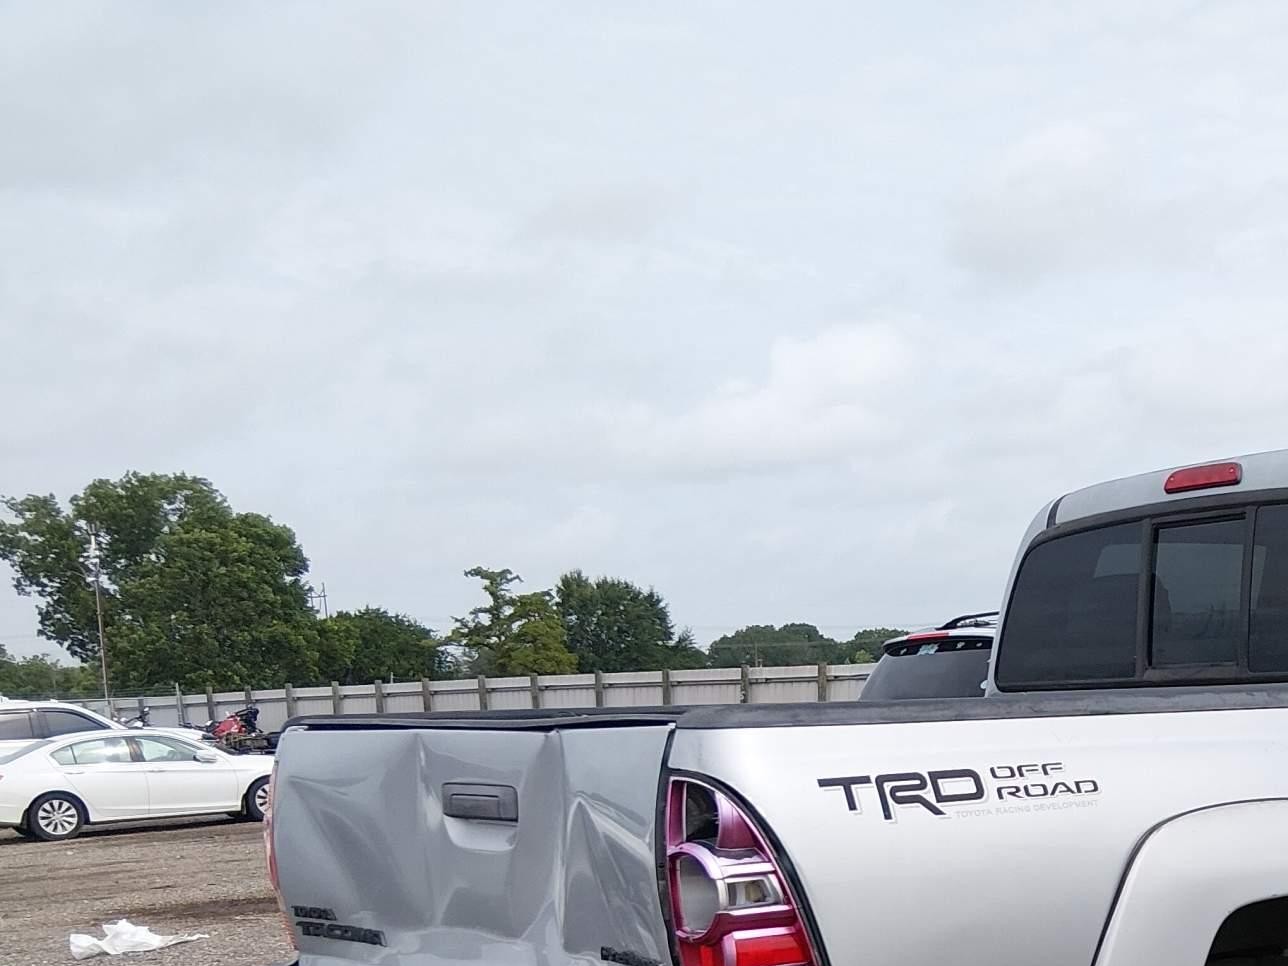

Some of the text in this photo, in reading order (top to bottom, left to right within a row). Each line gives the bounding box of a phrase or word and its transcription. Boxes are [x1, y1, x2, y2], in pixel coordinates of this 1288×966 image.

[990, 762, 1063, 779] OFF
[817, 767, 985, 821] TRD
[997, 780, 1099, 800] ROAD
[956, 799, 1099, 819] TOYOTA RACING DEVELOPMENT
[296, 921, 387, 947] TACOMA
